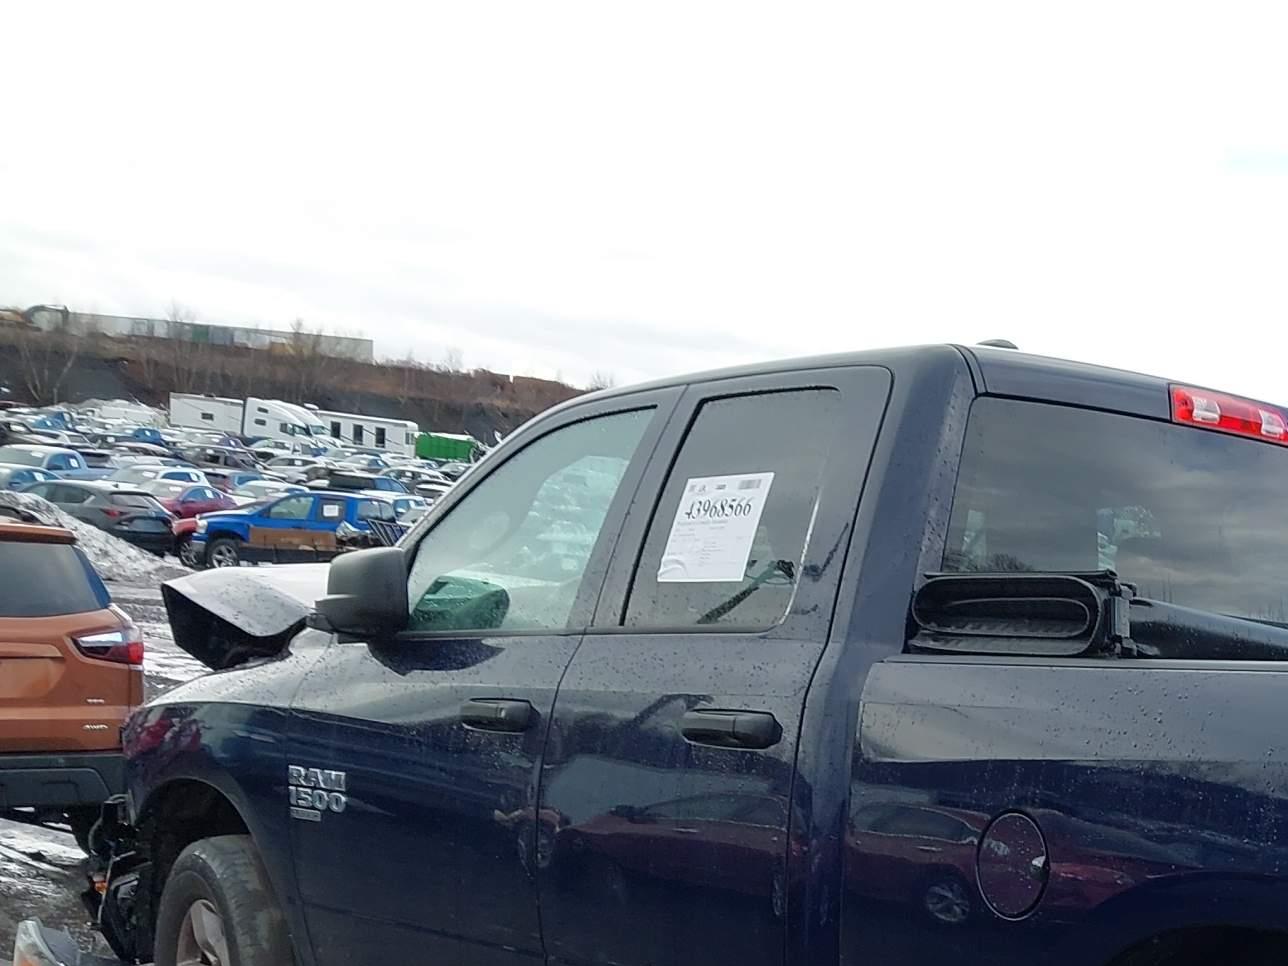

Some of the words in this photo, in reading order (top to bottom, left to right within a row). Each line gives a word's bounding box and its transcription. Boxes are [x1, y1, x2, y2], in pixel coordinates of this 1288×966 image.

[685, 496, 754, 520] 43968566
[288, 764, 346, 792] RAM
[288, 786, 347, 813] 1500
